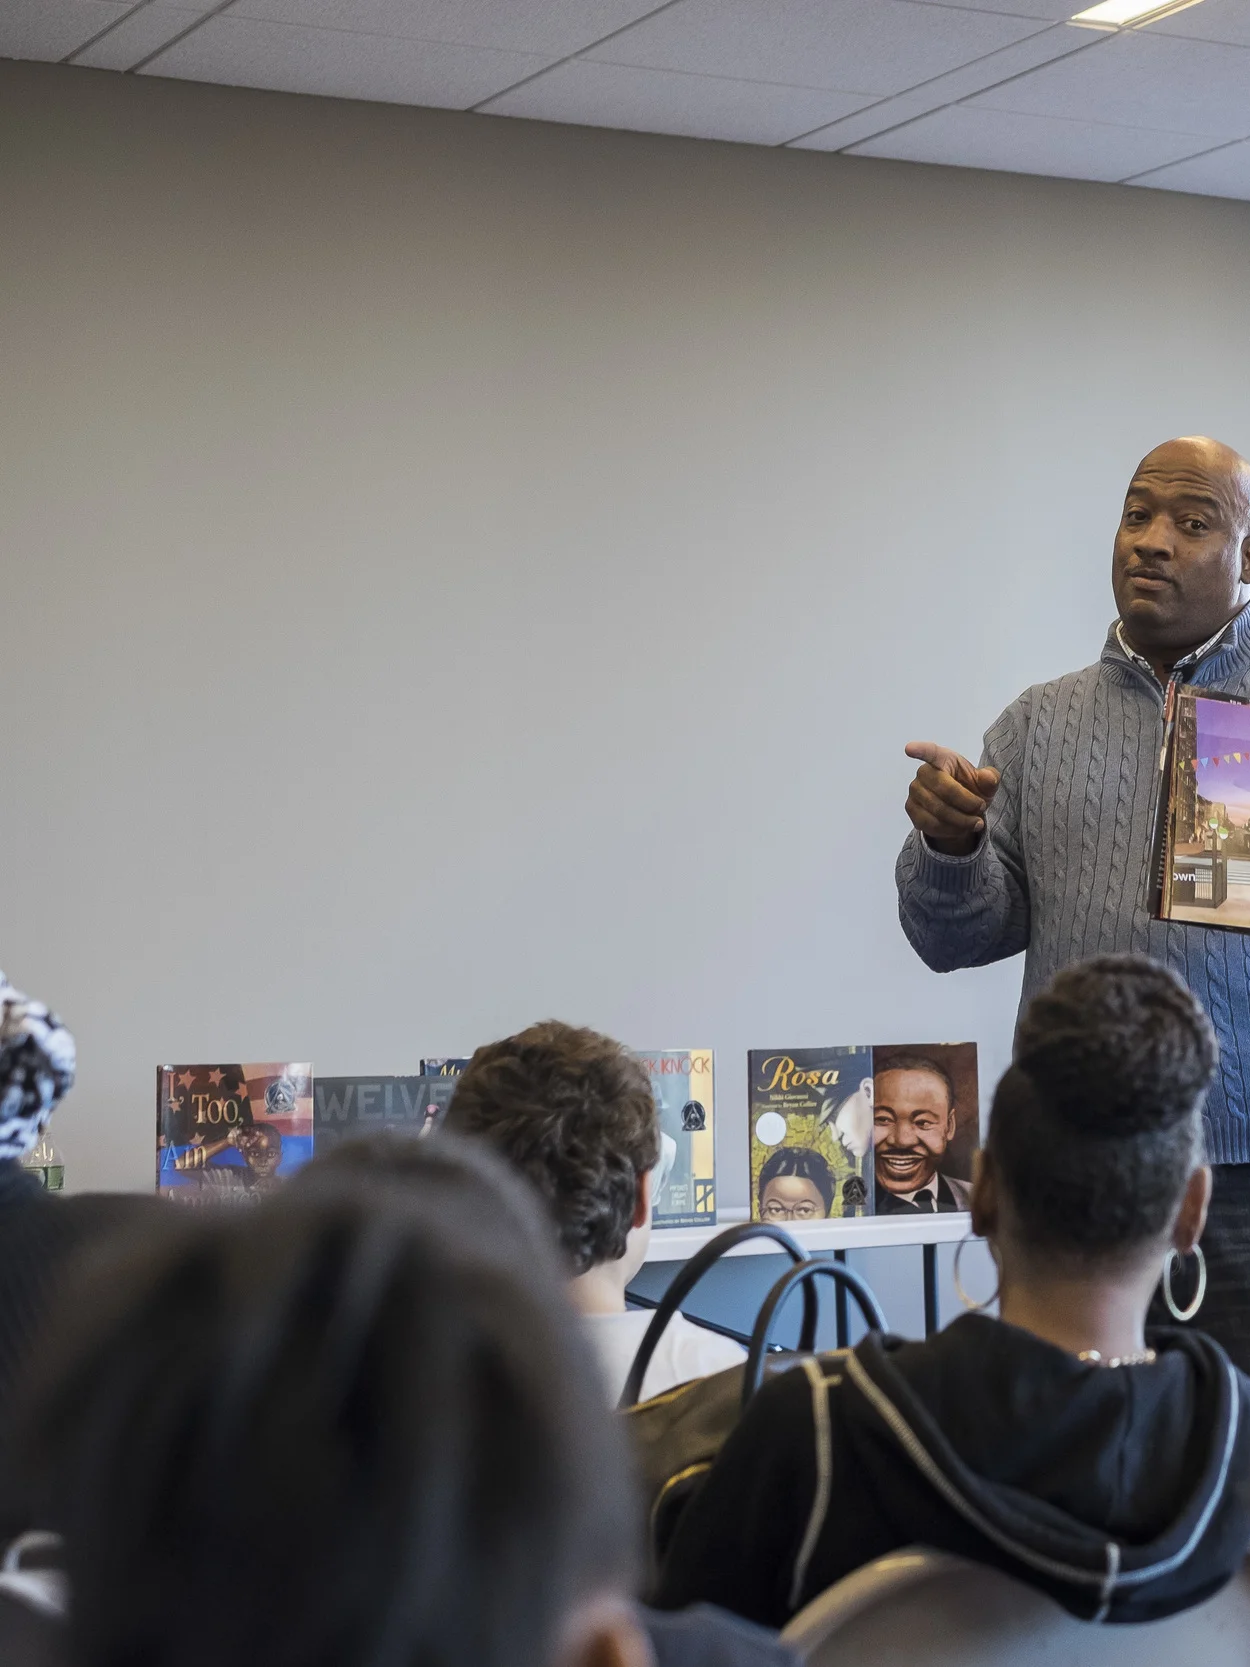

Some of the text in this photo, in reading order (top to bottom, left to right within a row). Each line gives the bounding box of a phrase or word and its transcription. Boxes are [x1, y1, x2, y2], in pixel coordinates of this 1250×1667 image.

[660, 1055, 710, 1076] KNOCK
[757, 1055, 840, 1092] Rosa
[167, 1072, 185, 1104] I,
[314, 1081, 453, 1123] WELVE
[162, 1140, 207, 1171] Am
